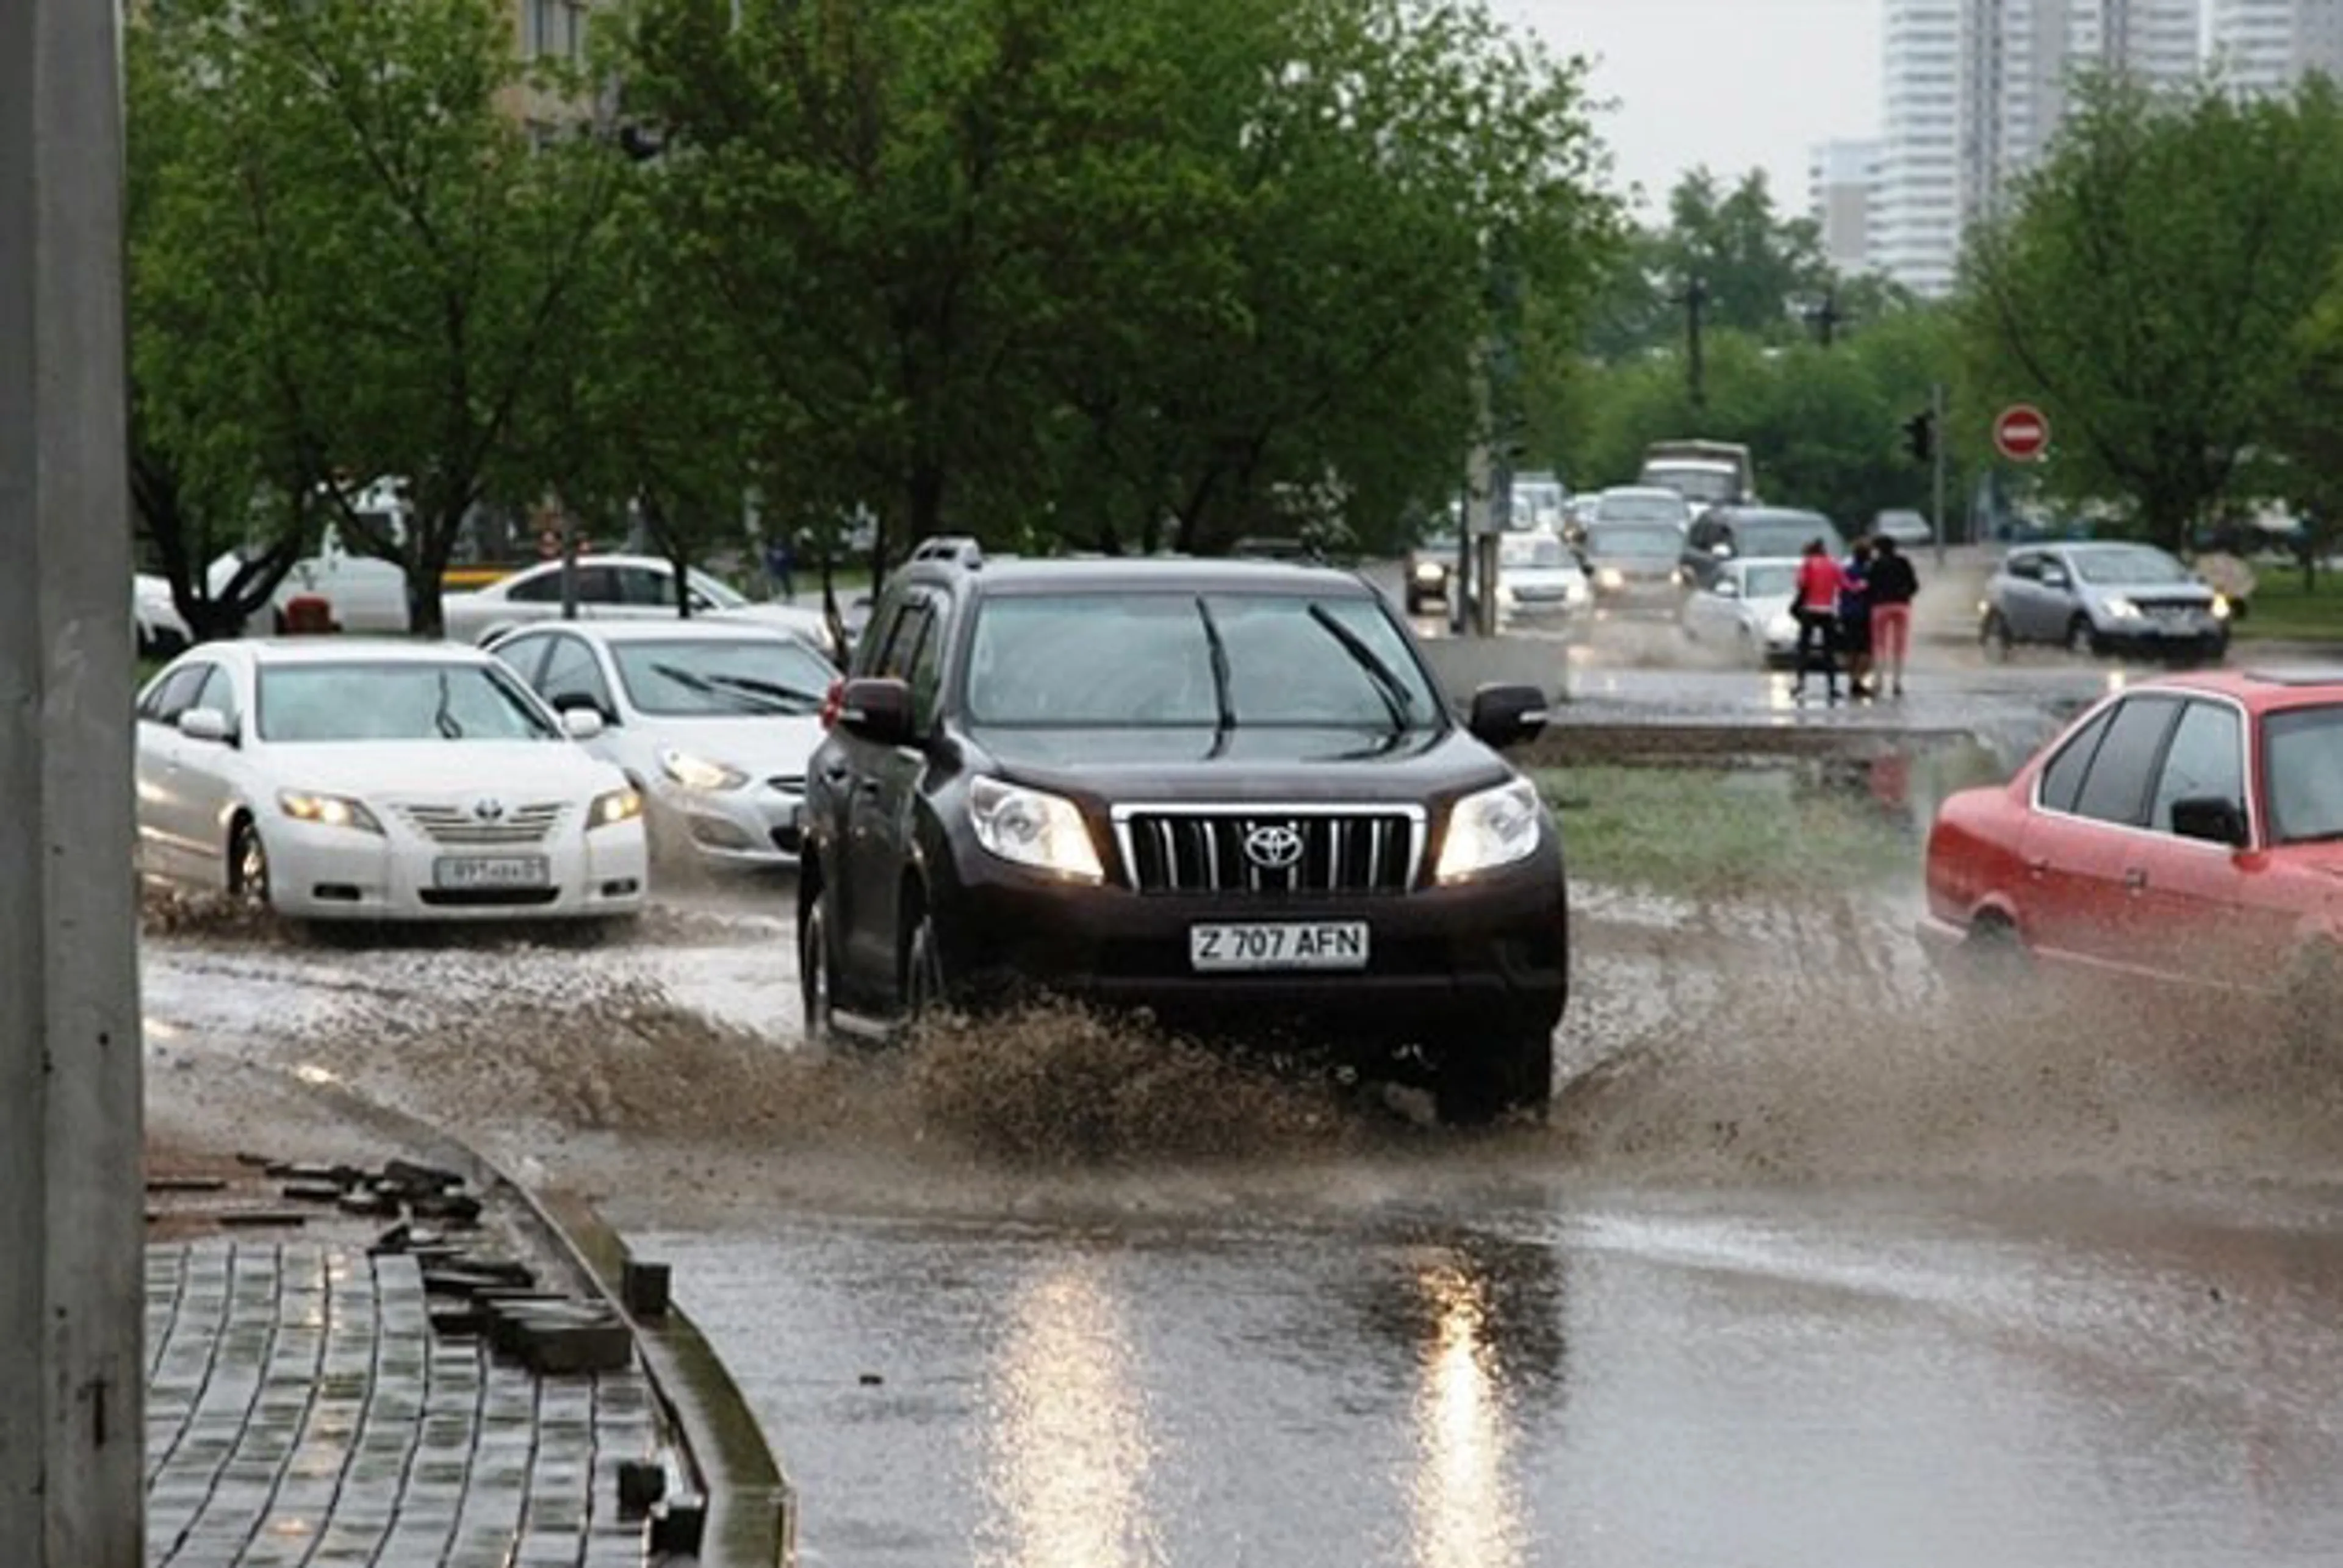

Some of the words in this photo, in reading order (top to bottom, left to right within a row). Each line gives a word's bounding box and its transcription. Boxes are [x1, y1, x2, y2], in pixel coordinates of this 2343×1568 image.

[1198, 929, 1222, 958] Z
[1232, 929, 1285, 957] 707
[1294, 928, 1360, 957] AFN
